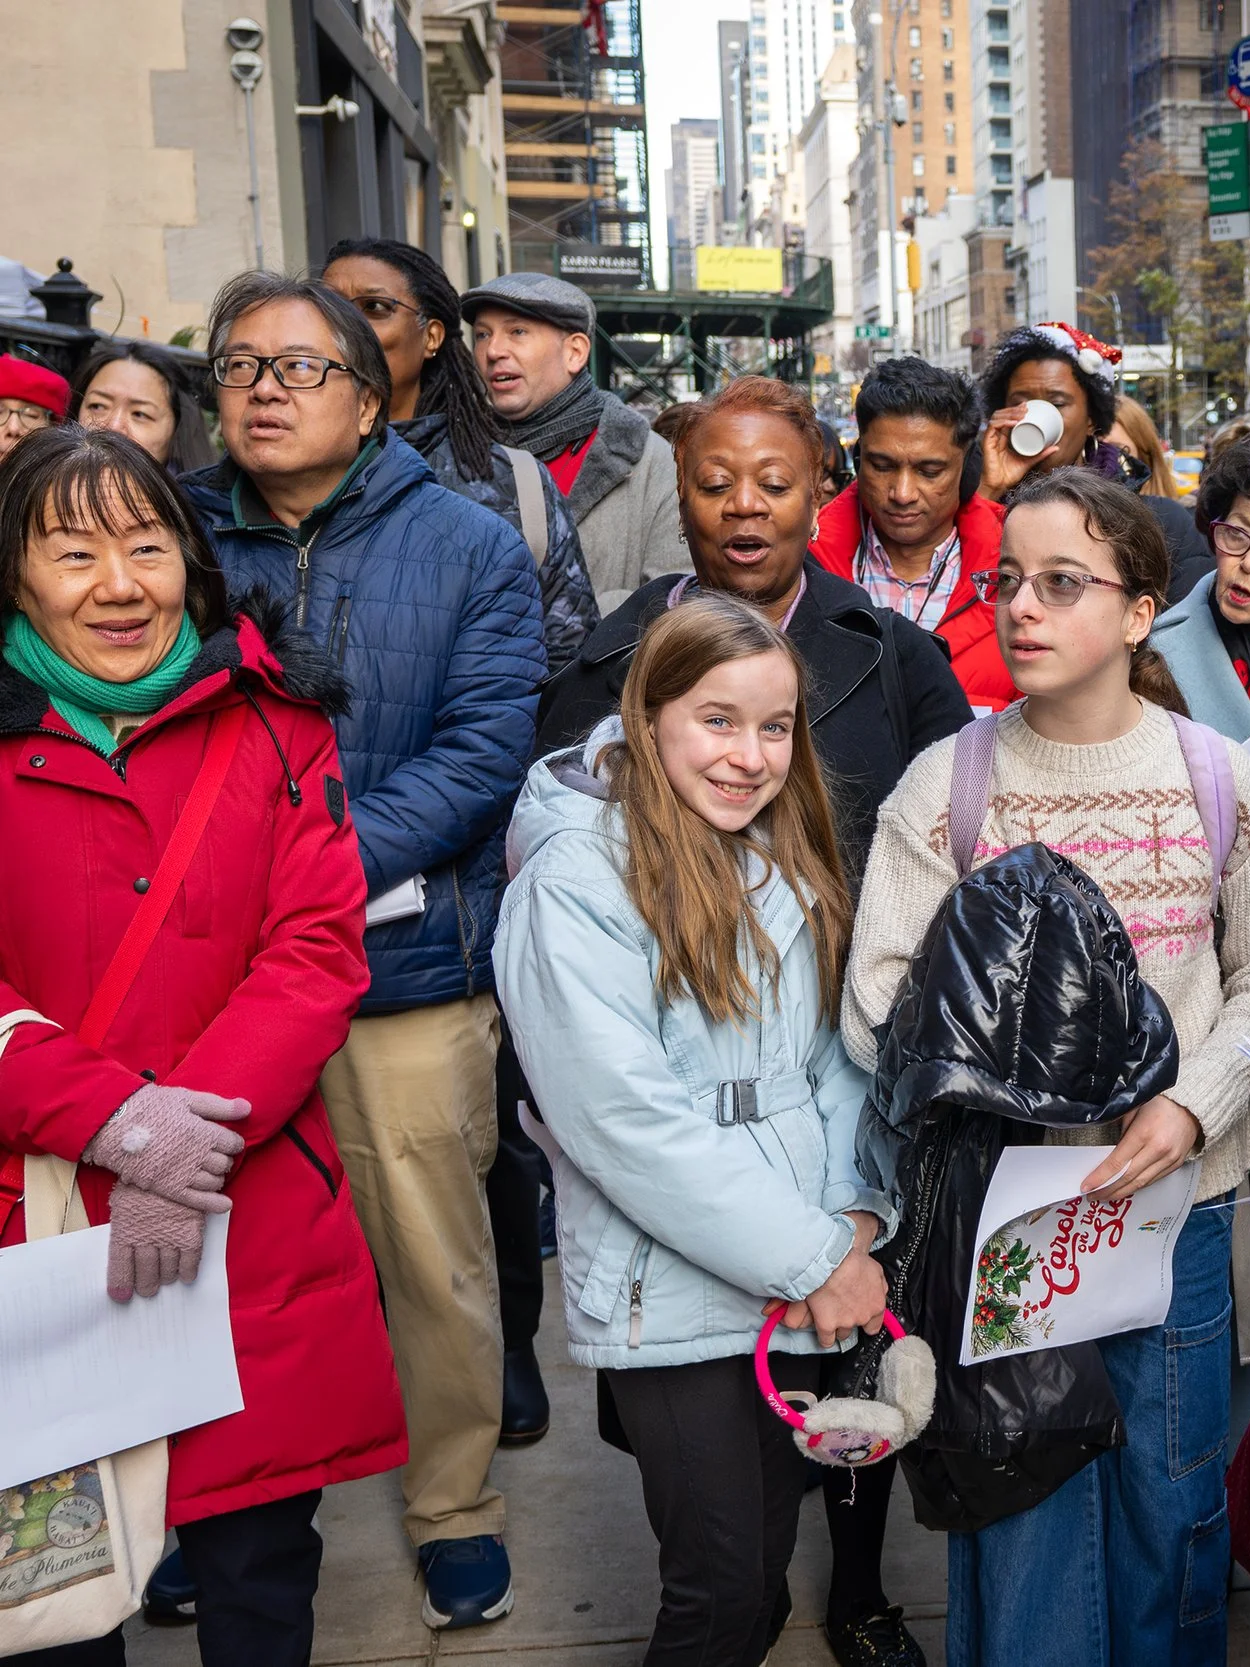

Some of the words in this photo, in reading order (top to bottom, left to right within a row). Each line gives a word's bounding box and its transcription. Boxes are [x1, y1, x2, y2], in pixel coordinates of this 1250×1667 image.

[1080, 1199, 1101, 1226] the
[1039, 1195, 1083, 1309] Carols
[1078, 1231, 1089, 1254] on
[0, 1574, 17, 1592] he
[22, 1546, 109, 1584] Plumeria
